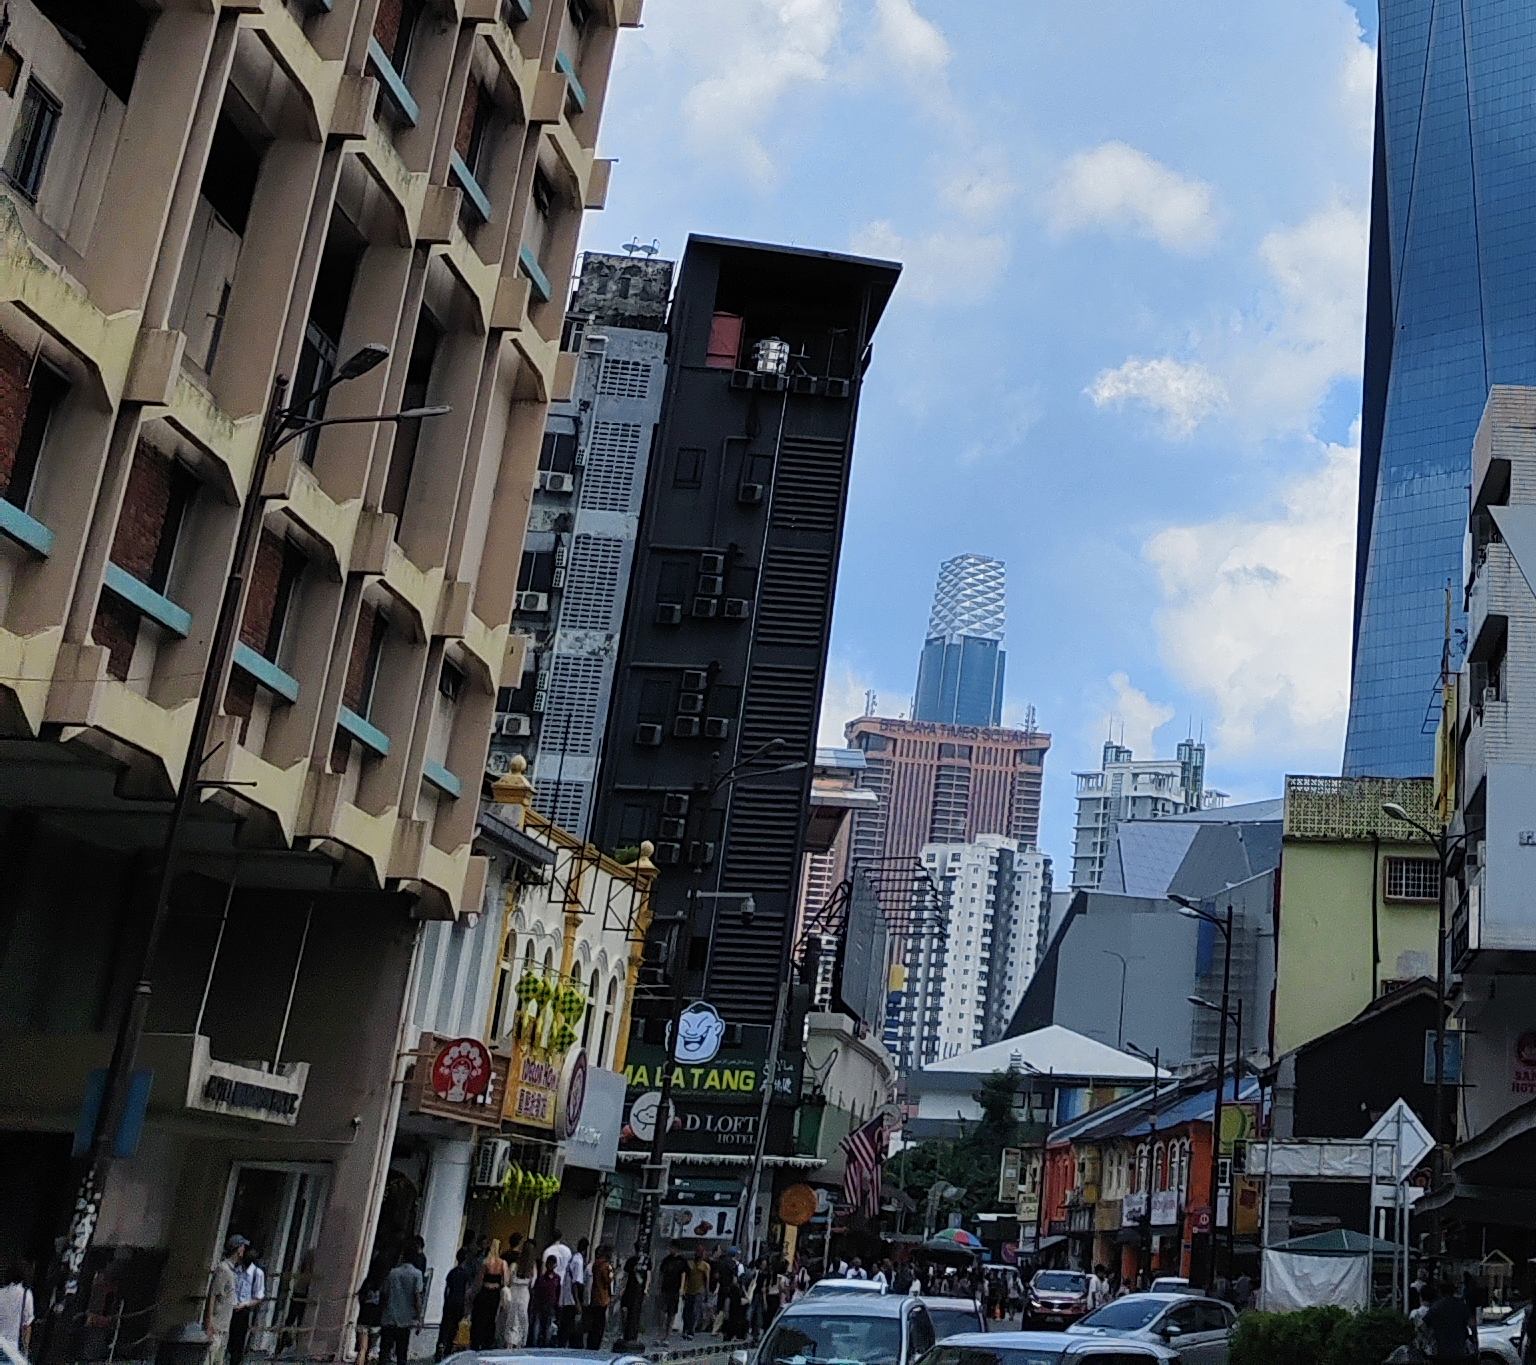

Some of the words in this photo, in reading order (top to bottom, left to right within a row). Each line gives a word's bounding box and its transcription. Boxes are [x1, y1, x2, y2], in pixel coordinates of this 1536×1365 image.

[940, 724, 979, 740] TIMES
[690, 1068, 757, 1092] TANG
[684, 1113, 701, 1131] D
[706, 1114, 759, 1134] LOFT
[717, 1134, 757, 1145] HOTEL
